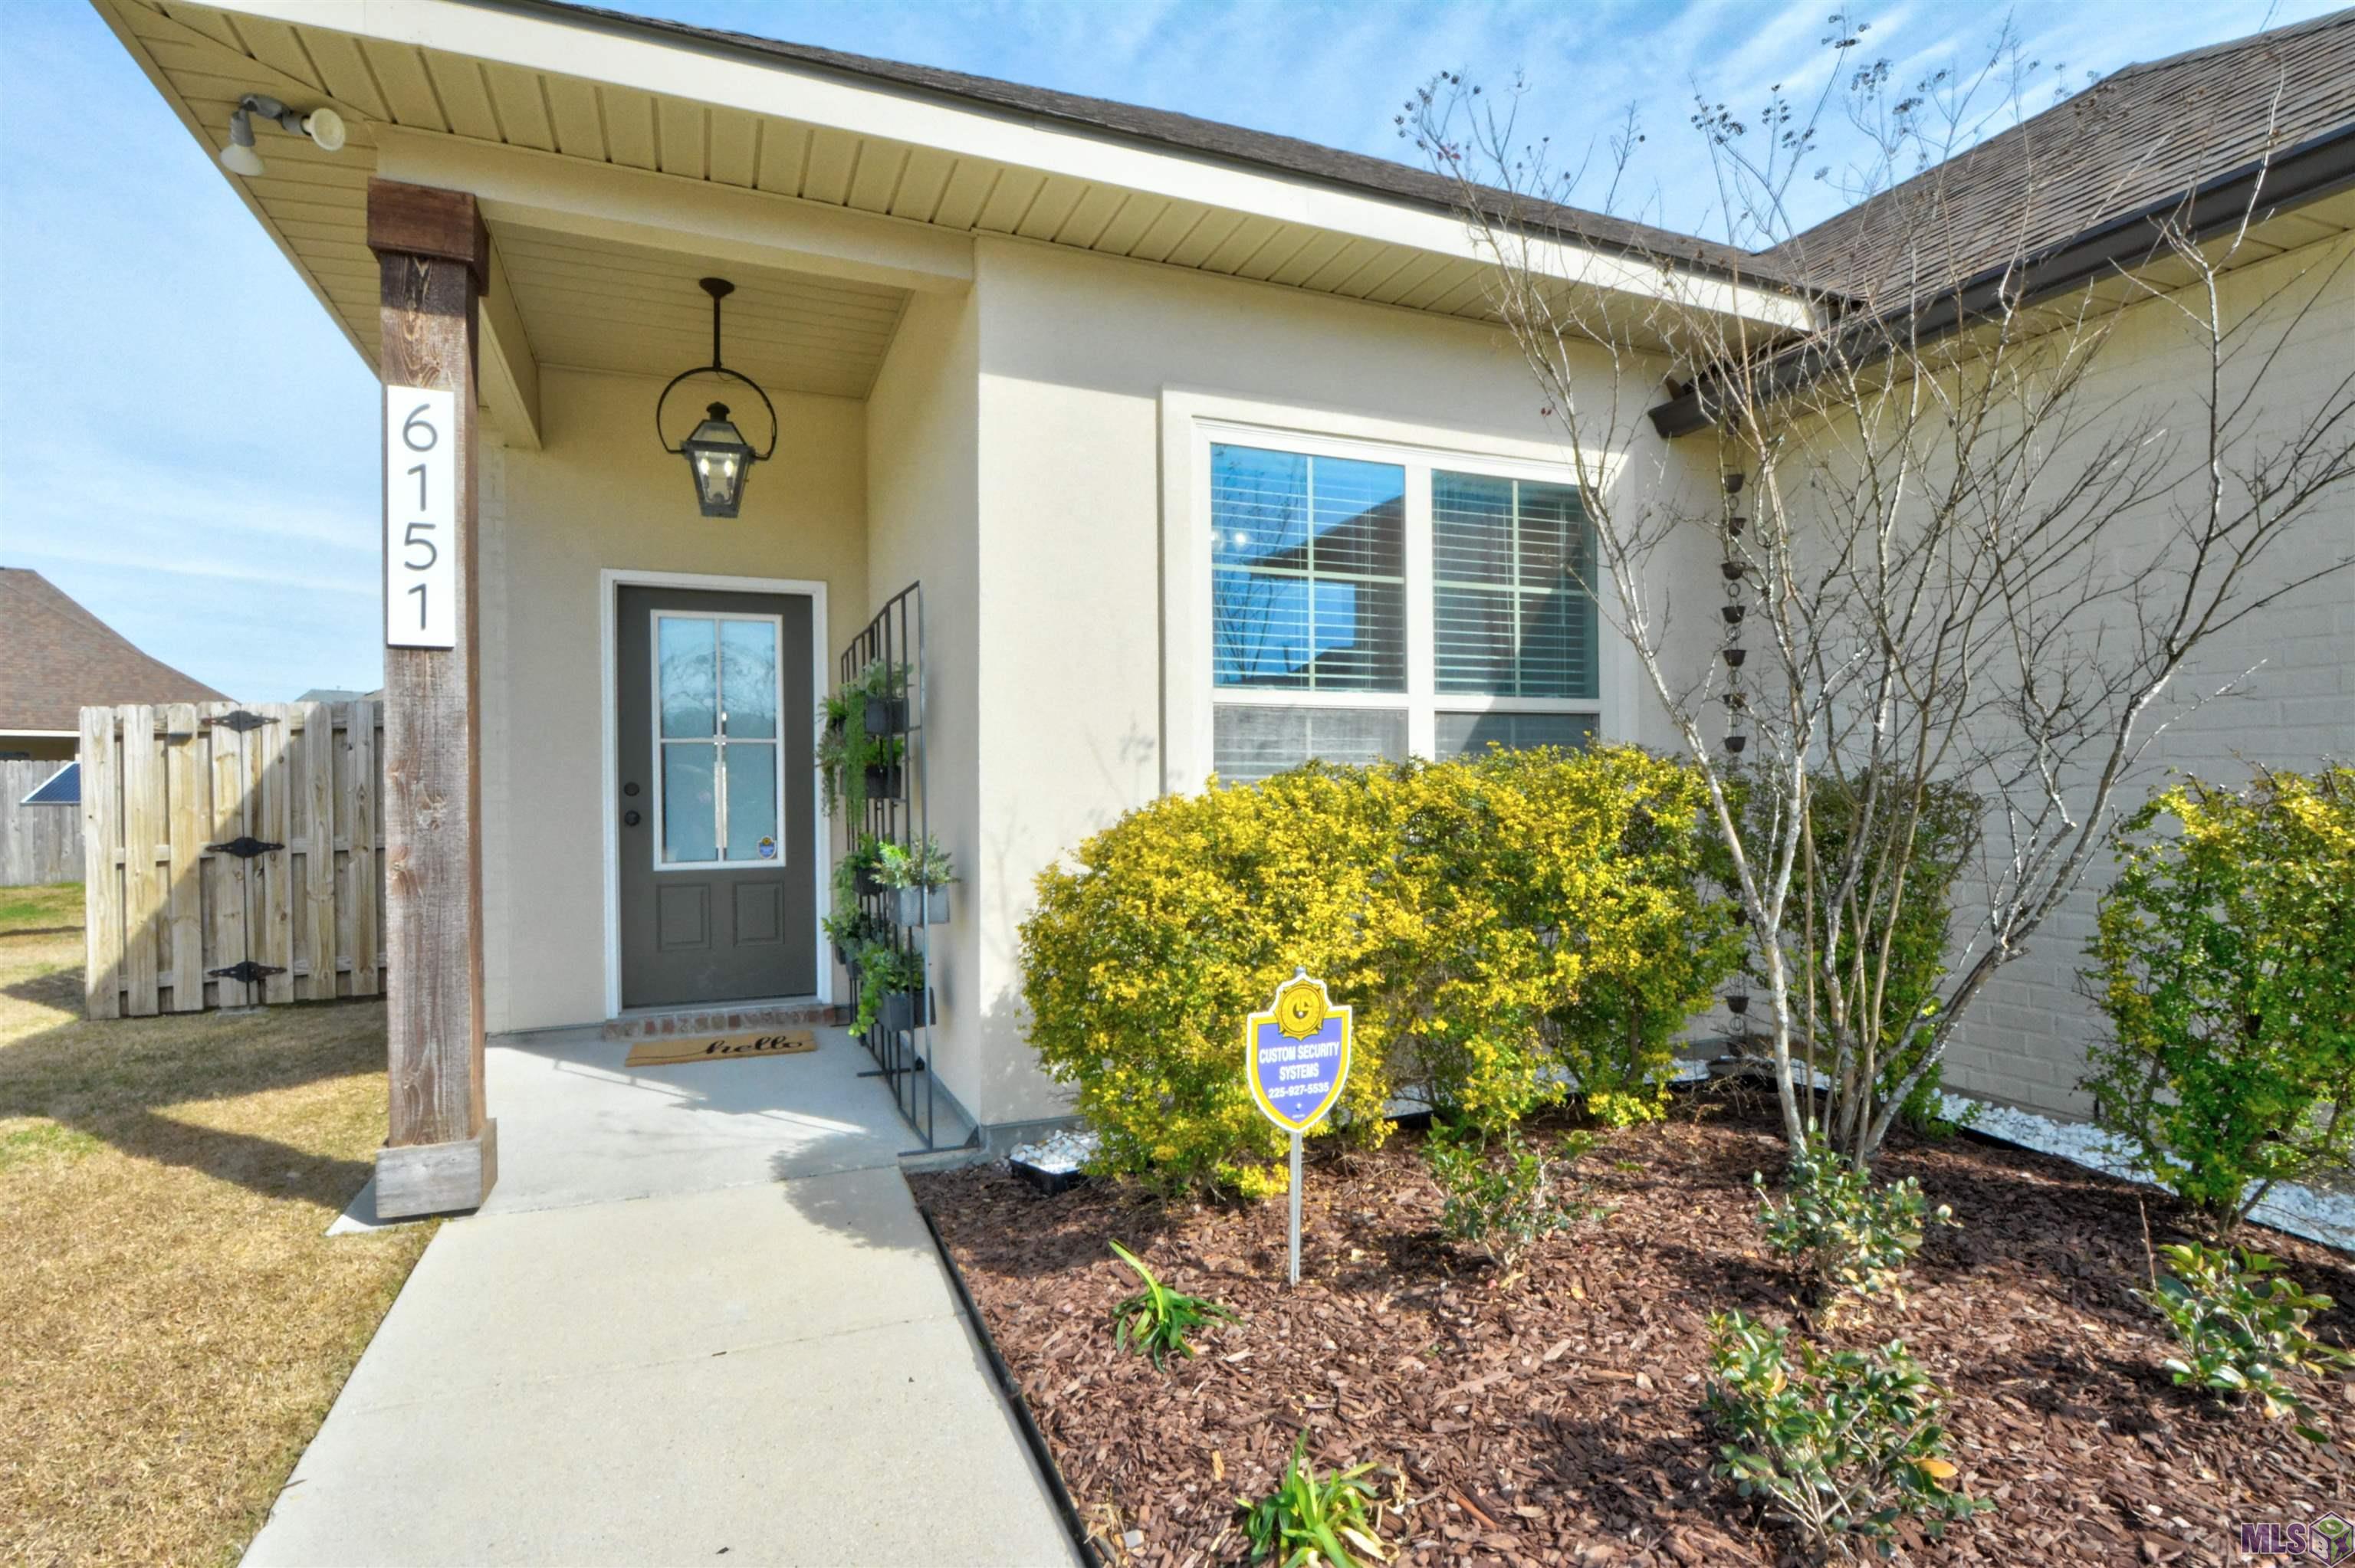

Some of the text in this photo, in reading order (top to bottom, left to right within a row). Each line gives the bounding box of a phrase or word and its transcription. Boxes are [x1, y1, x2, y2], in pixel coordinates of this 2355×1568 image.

[402, 403, 438, 631] 6151
[701, 1035, 804, 1055] hello
[1259, 1042, 1340, 1064] CUSTOM SECURITY
[1279, 1062, 1319, 1081] SYSTEMS
[1268, 1081, 1329, 1099] 225-927-5535
